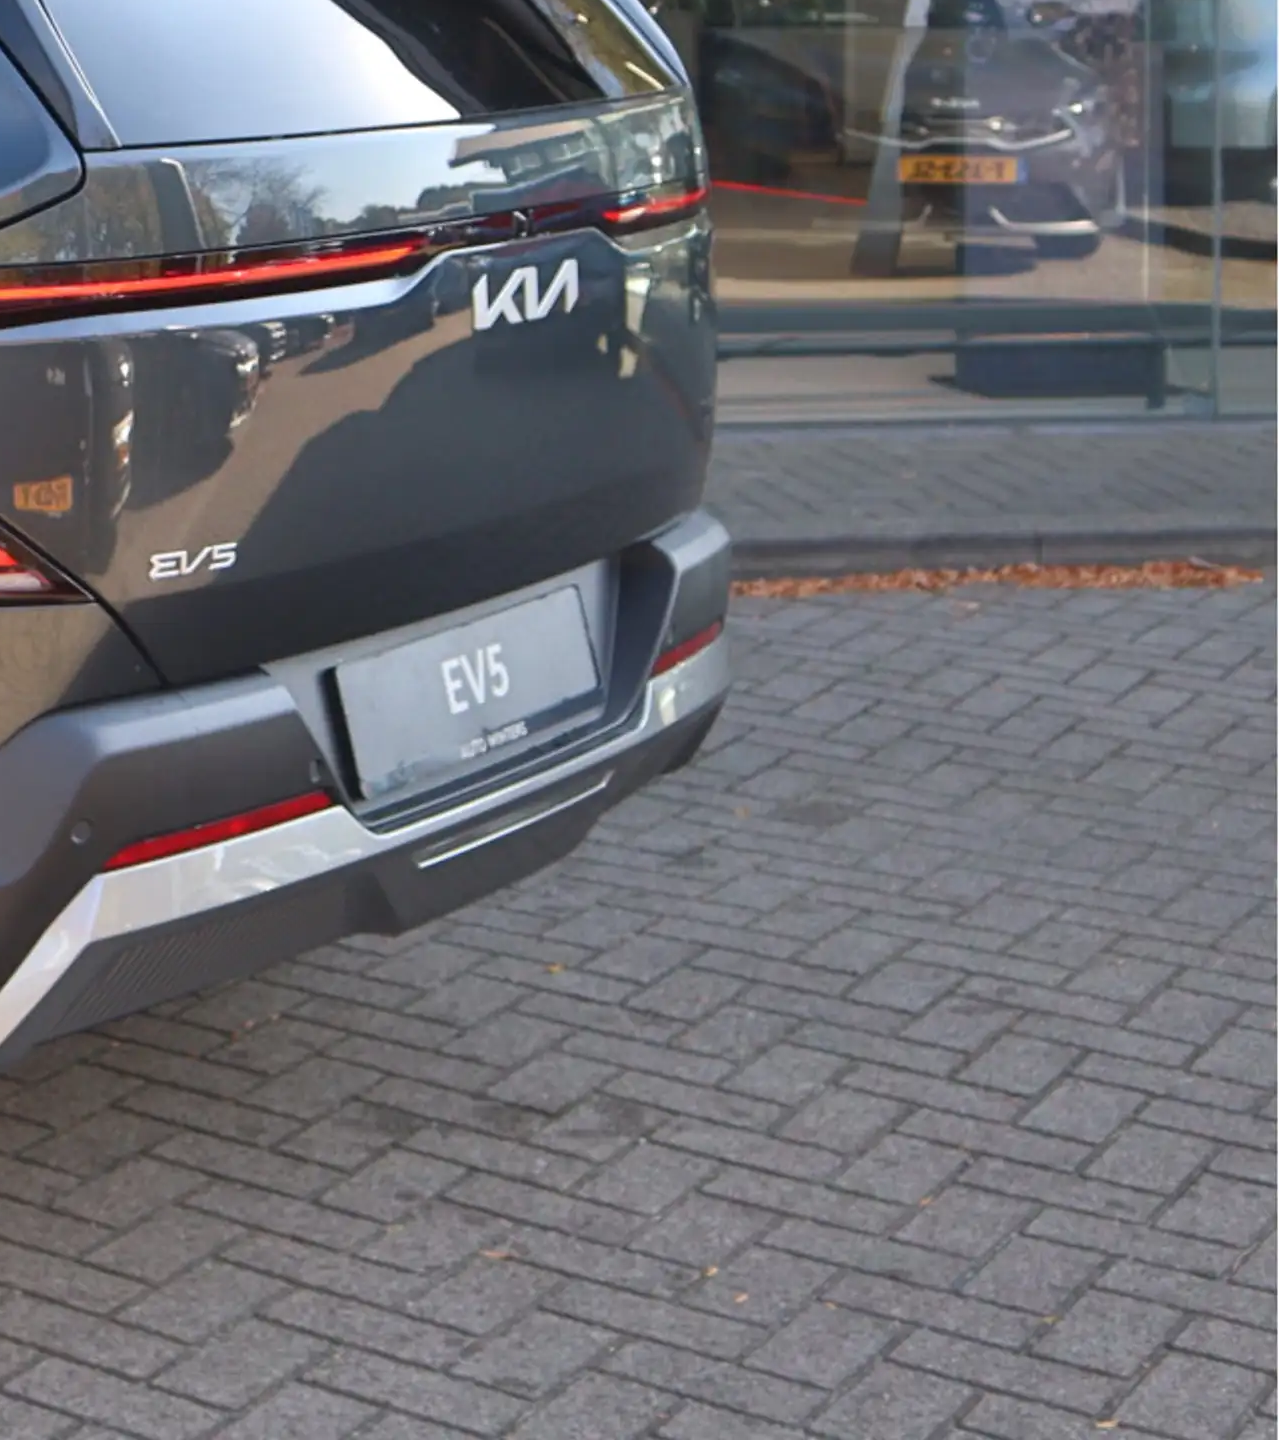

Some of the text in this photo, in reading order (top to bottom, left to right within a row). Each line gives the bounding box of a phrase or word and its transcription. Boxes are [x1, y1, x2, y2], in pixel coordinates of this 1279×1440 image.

[471, 258, 580, 331] KIA
[149, 542, 238, 581] EV5
[441, 642, 511, 714] EV5
[460, 734, 488, 759] AUTO
